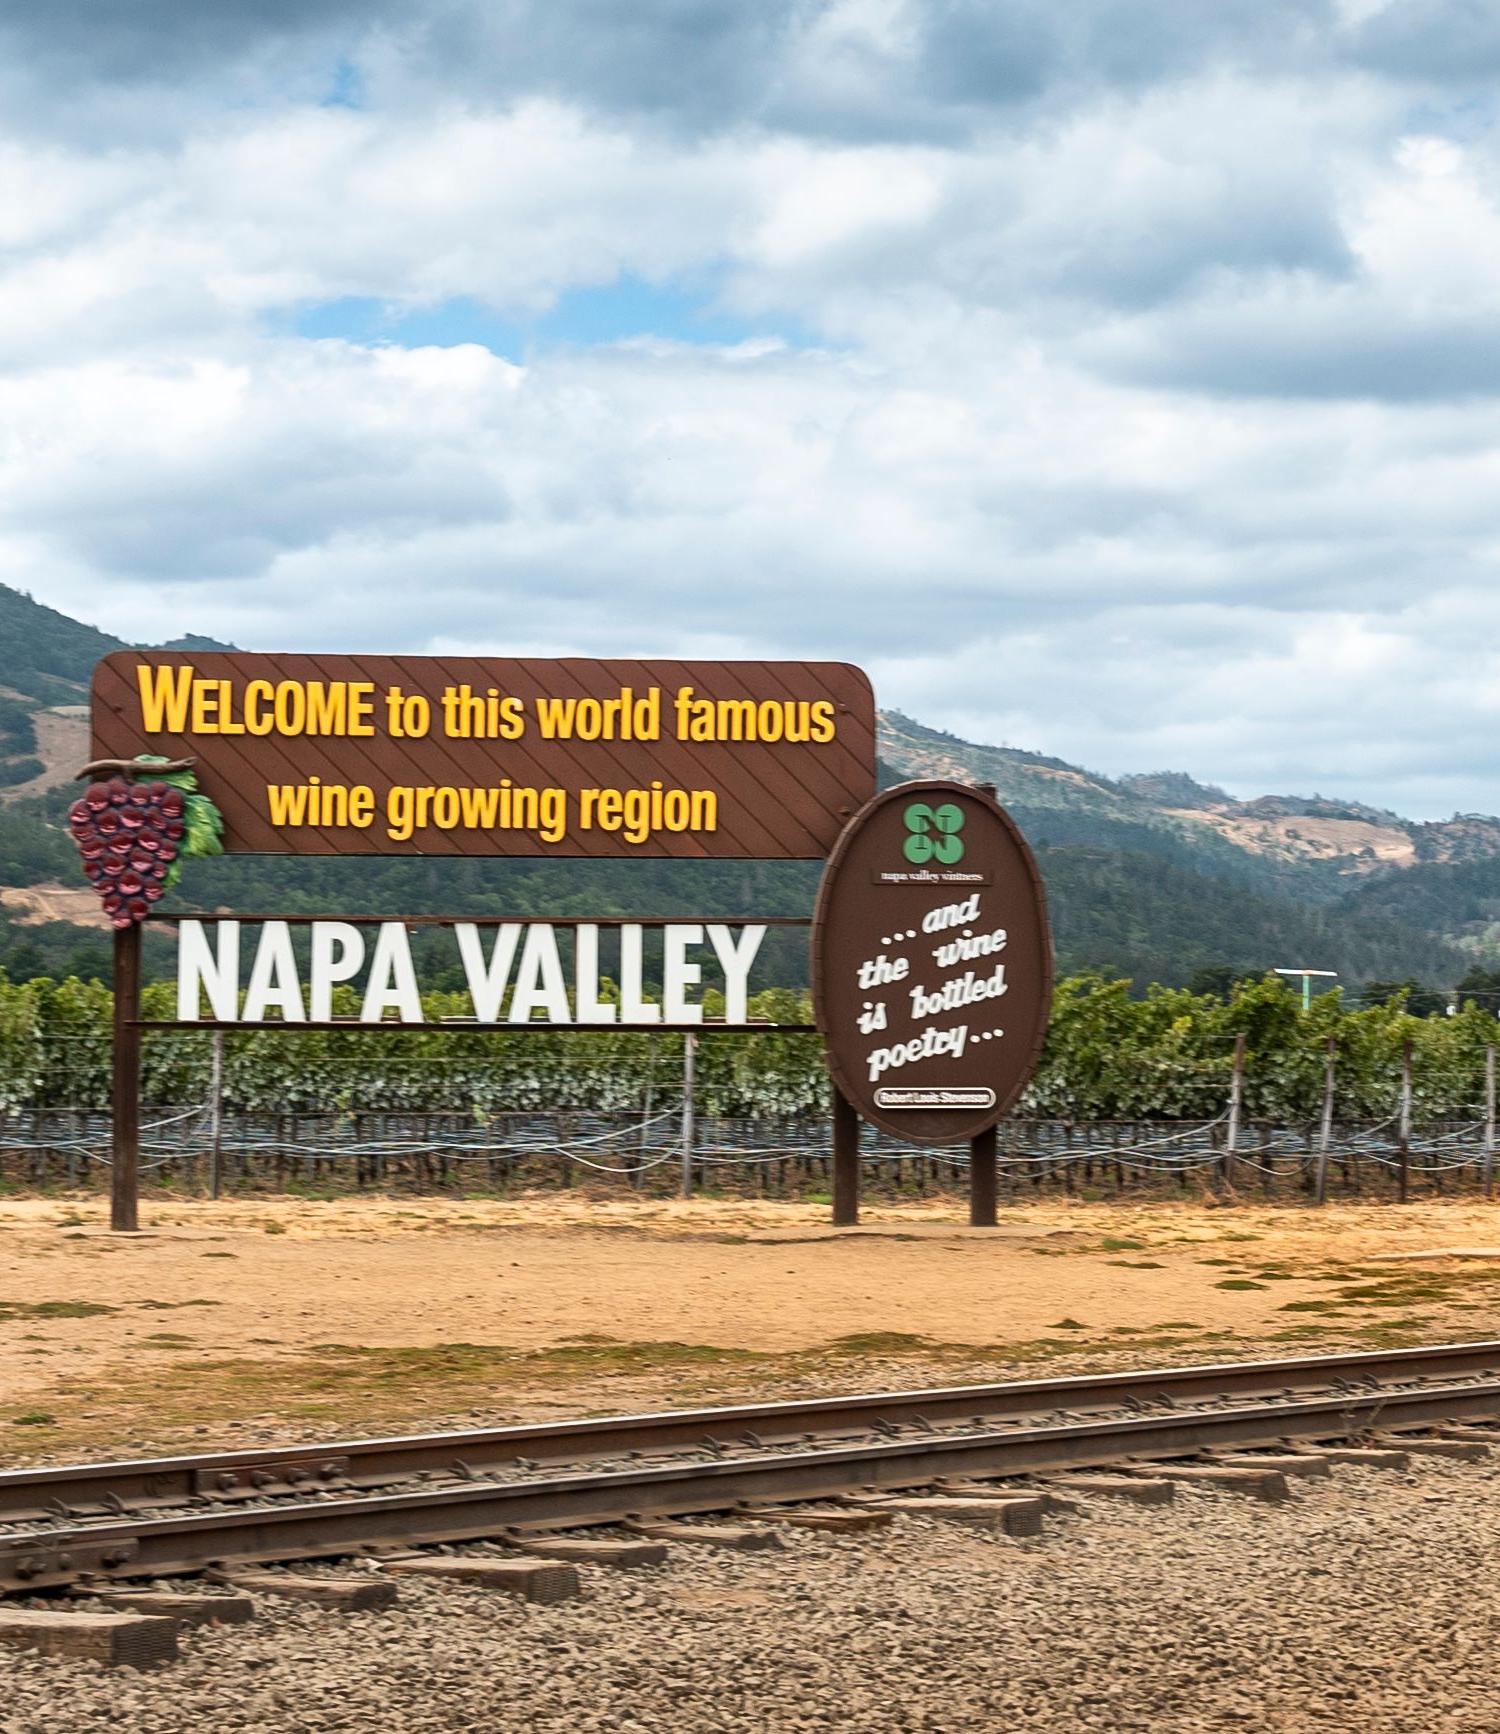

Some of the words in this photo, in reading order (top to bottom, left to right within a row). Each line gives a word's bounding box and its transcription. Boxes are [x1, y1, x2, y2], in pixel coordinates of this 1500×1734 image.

[136, 664, 375, 736] WELCOME
[385, 686, 430, 738] to
[441, 684, 525, 740] this
[535, 686, 660, 742] world
[674, 686, 836, 743] famous
[267, 776, 375, 828] wine
[387, 778, 566, 843] growing
[580, 780, 717, 844] region
[179, 920, 424, 1024] NAPA
[456, 923, 768, 1025] VALLEY
[856, 955, 910, 990] the
[932, 928, 1008, 968] wine
[856, 1001, 888, 1035] is
[909, 965, 1008, 1021] bottled
